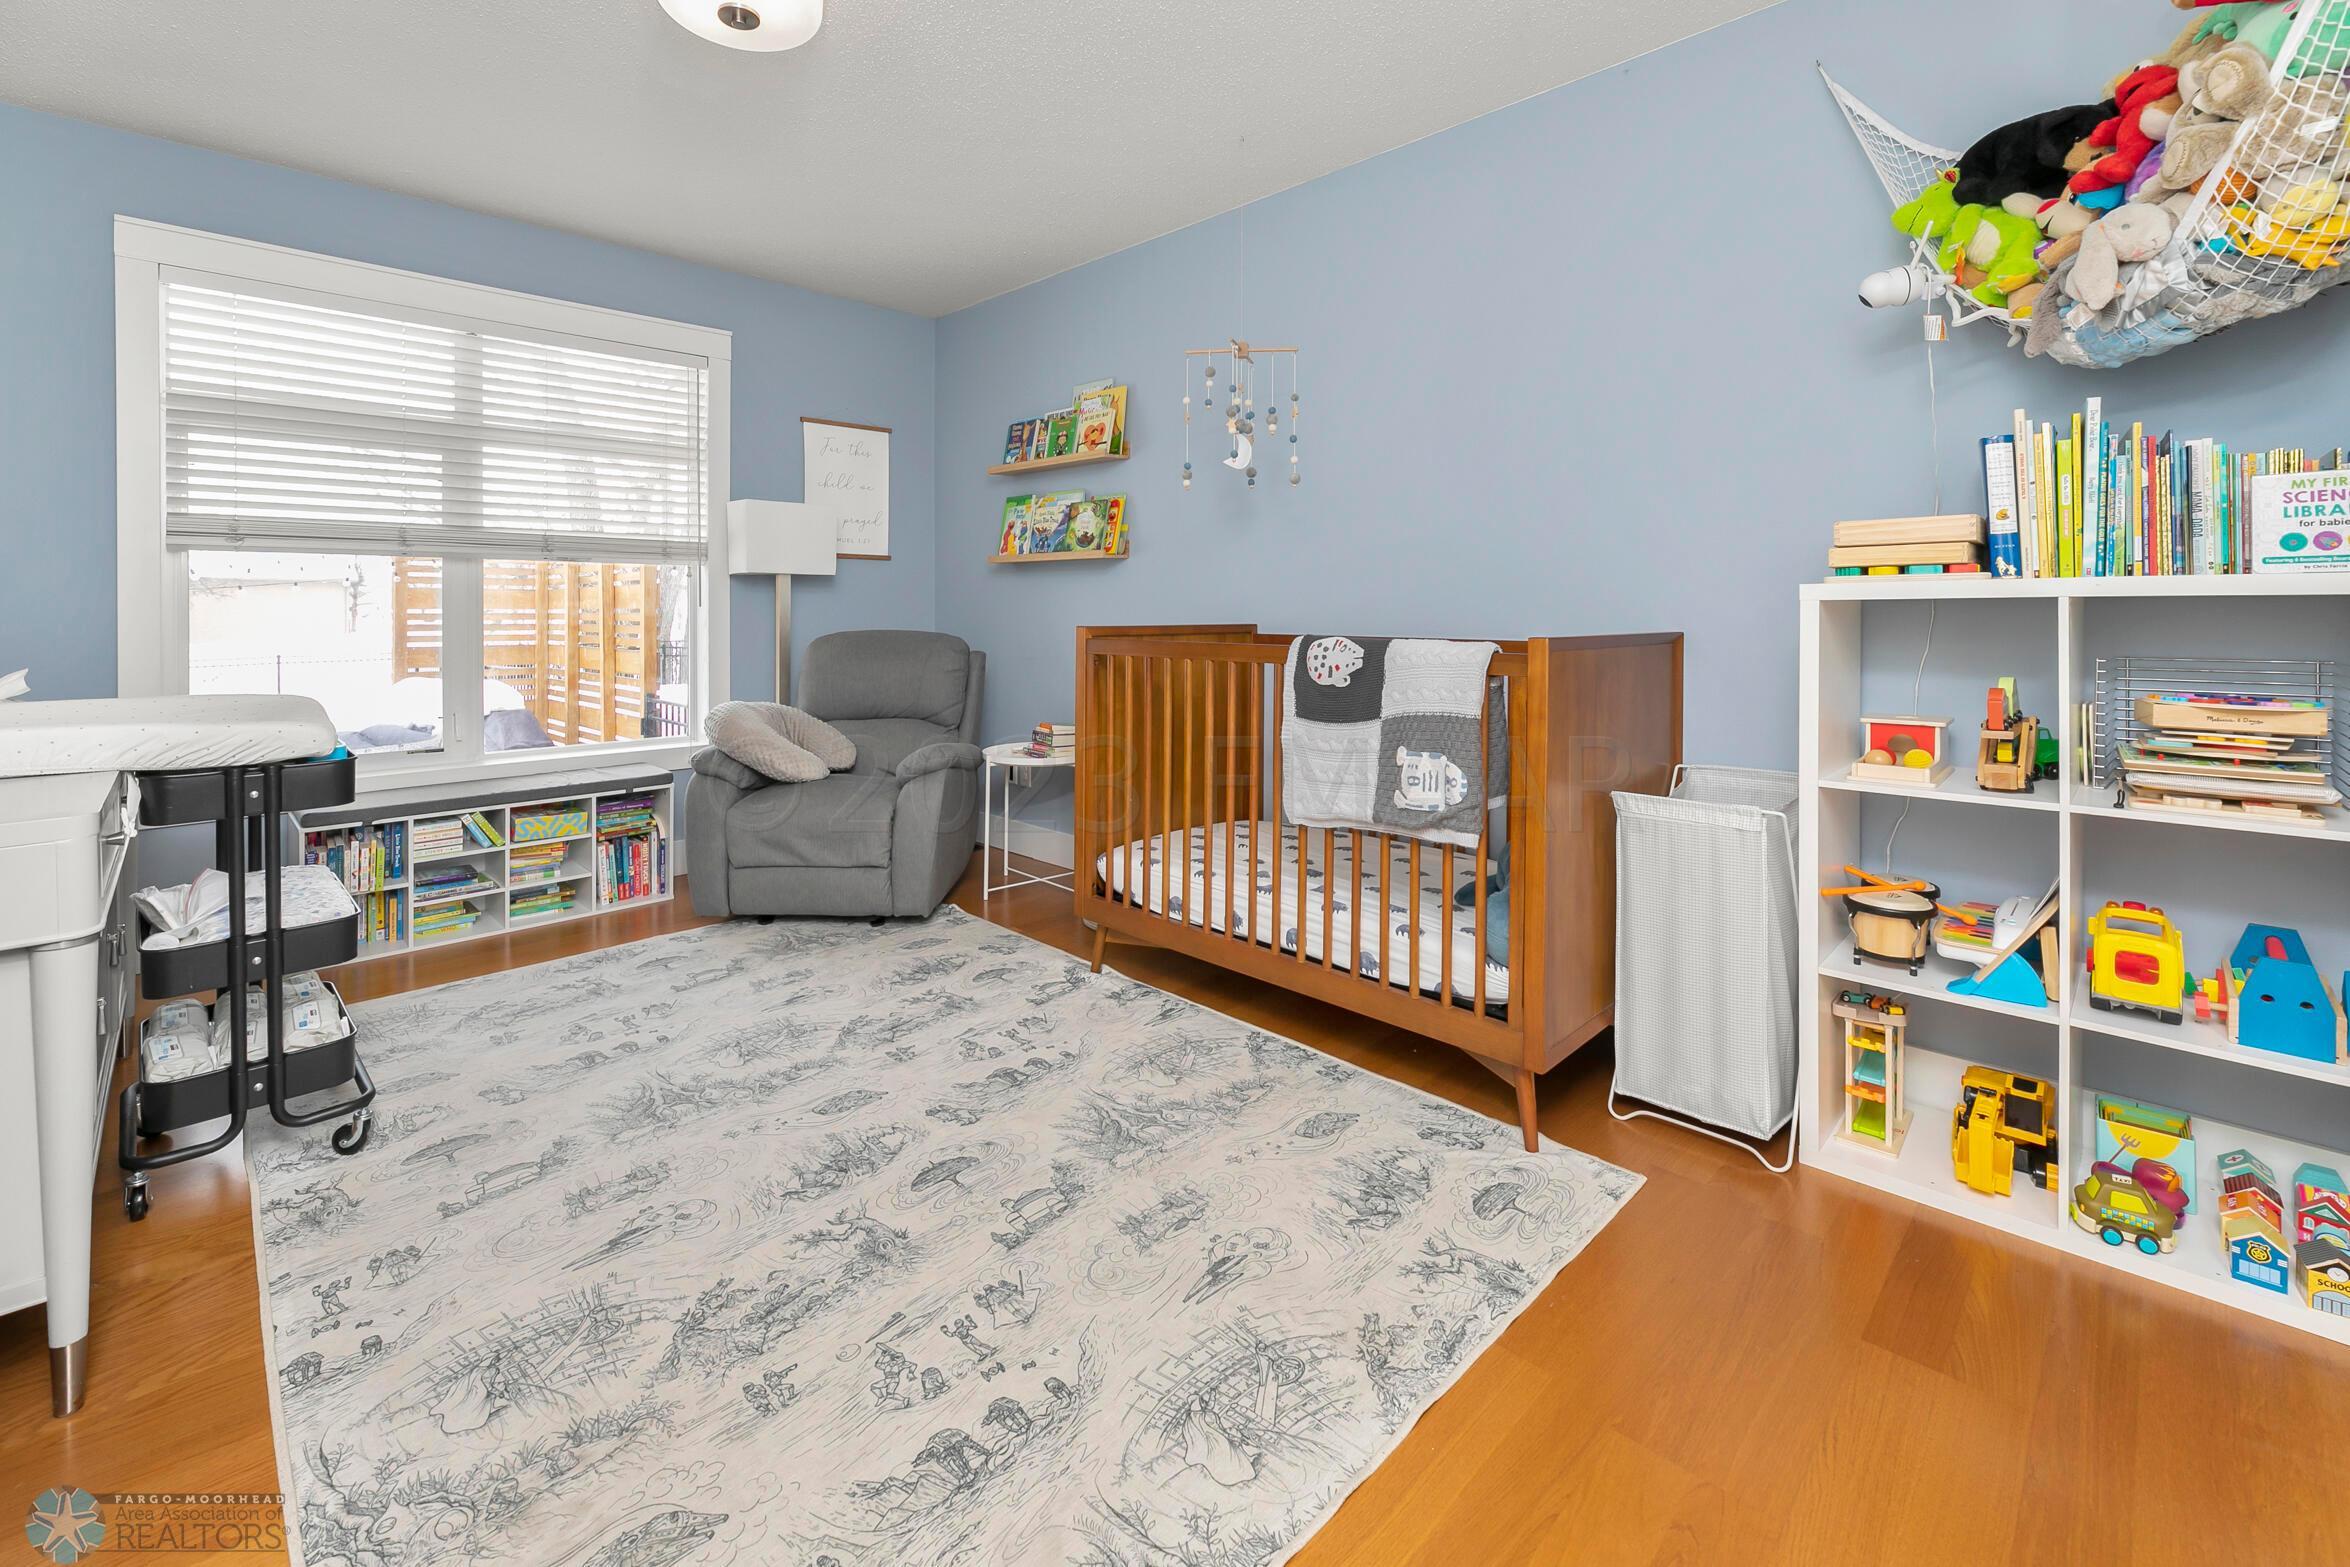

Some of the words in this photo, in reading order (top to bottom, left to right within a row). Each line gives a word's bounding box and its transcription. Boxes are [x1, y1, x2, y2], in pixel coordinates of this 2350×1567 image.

[819, 436, 842, 457] For
[848, 441, 873, 458] this
[817, 471, 854, 490] child
[2291, 478, 2317, 489] MY
[2323, 476, 2349, 487] FIR
[2192, 491, 2203, 513] MAMA
[2282, 489, 2350, 504] SCIEN
[2283, 503, 2350, 518] LIBRA
[2192, 518, 2203, 538] DADA
[2299, 519, 2316, 527] for
[2317, 1278, 2350, 1293] SCHOO
